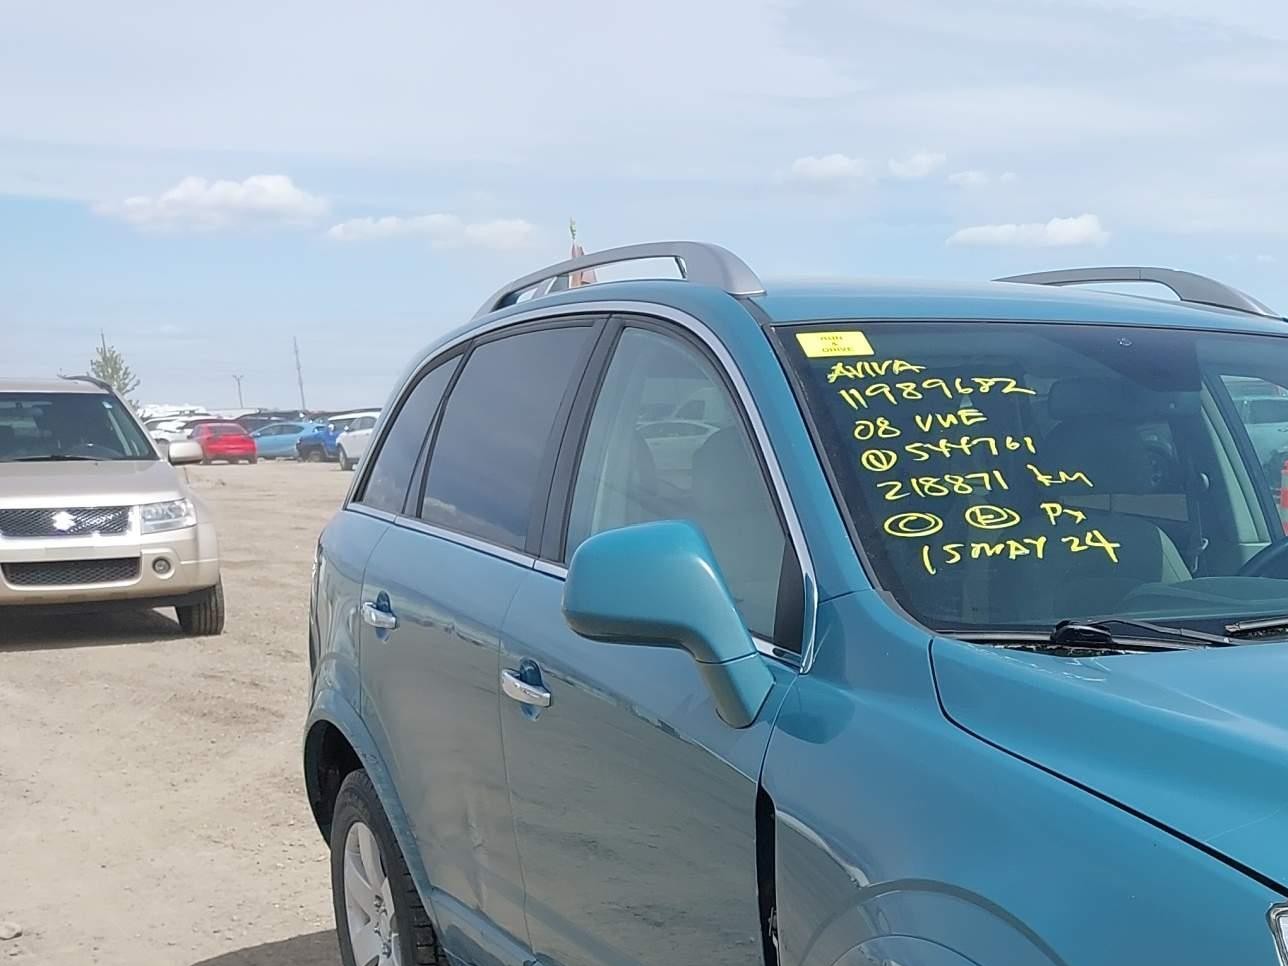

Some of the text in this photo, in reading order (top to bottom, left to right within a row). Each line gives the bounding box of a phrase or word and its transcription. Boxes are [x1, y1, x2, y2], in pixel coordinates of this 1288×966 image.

[827, 359, 927, 383] AVIVA
[837, 377, 1037, 410] 11989682
[853, 416, 902, 440] 08
[876, 470, 1009, 501] 218871
[1060, 529, 1121, 563] 24
